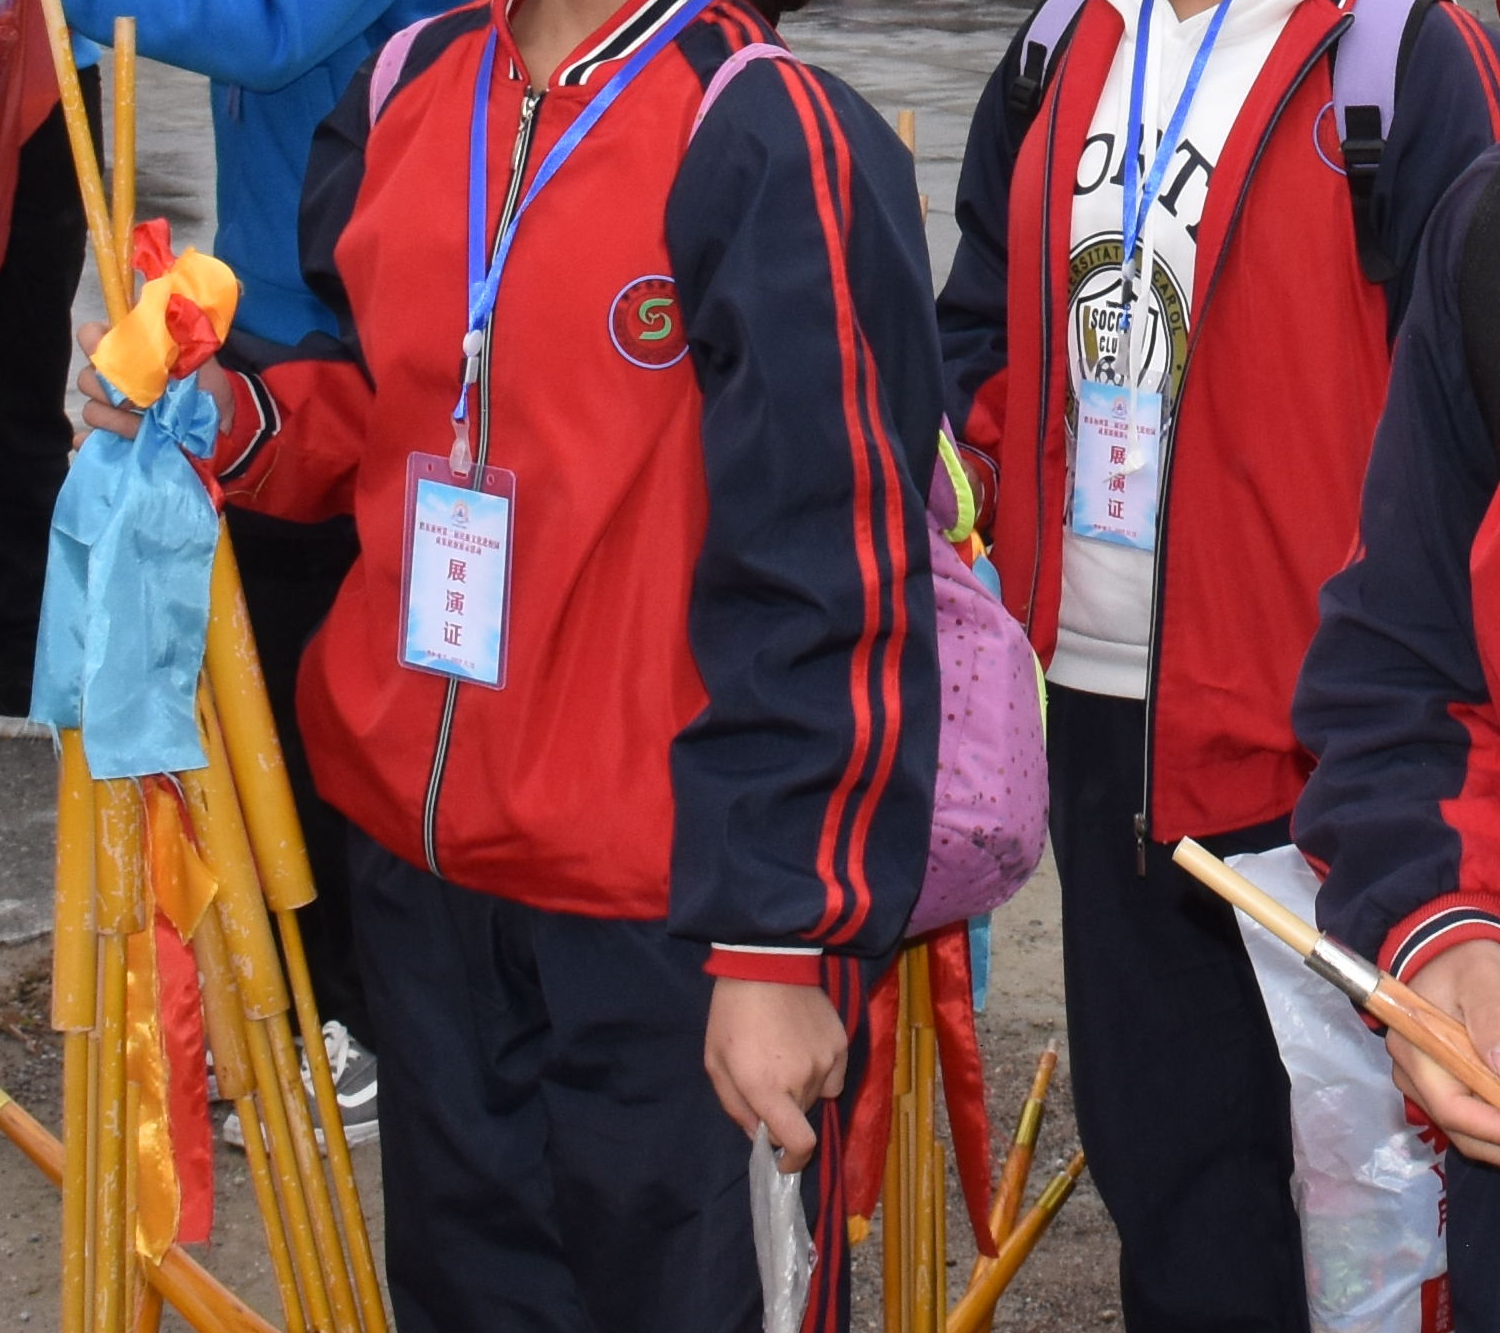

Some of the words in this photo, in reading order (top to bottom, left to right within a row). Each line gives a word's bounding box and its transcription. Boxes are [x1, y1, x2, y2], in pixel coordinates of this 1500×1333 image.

[1106, 444, 1126, 520] 展演证
[443, 558, 468, 647] 展演证
